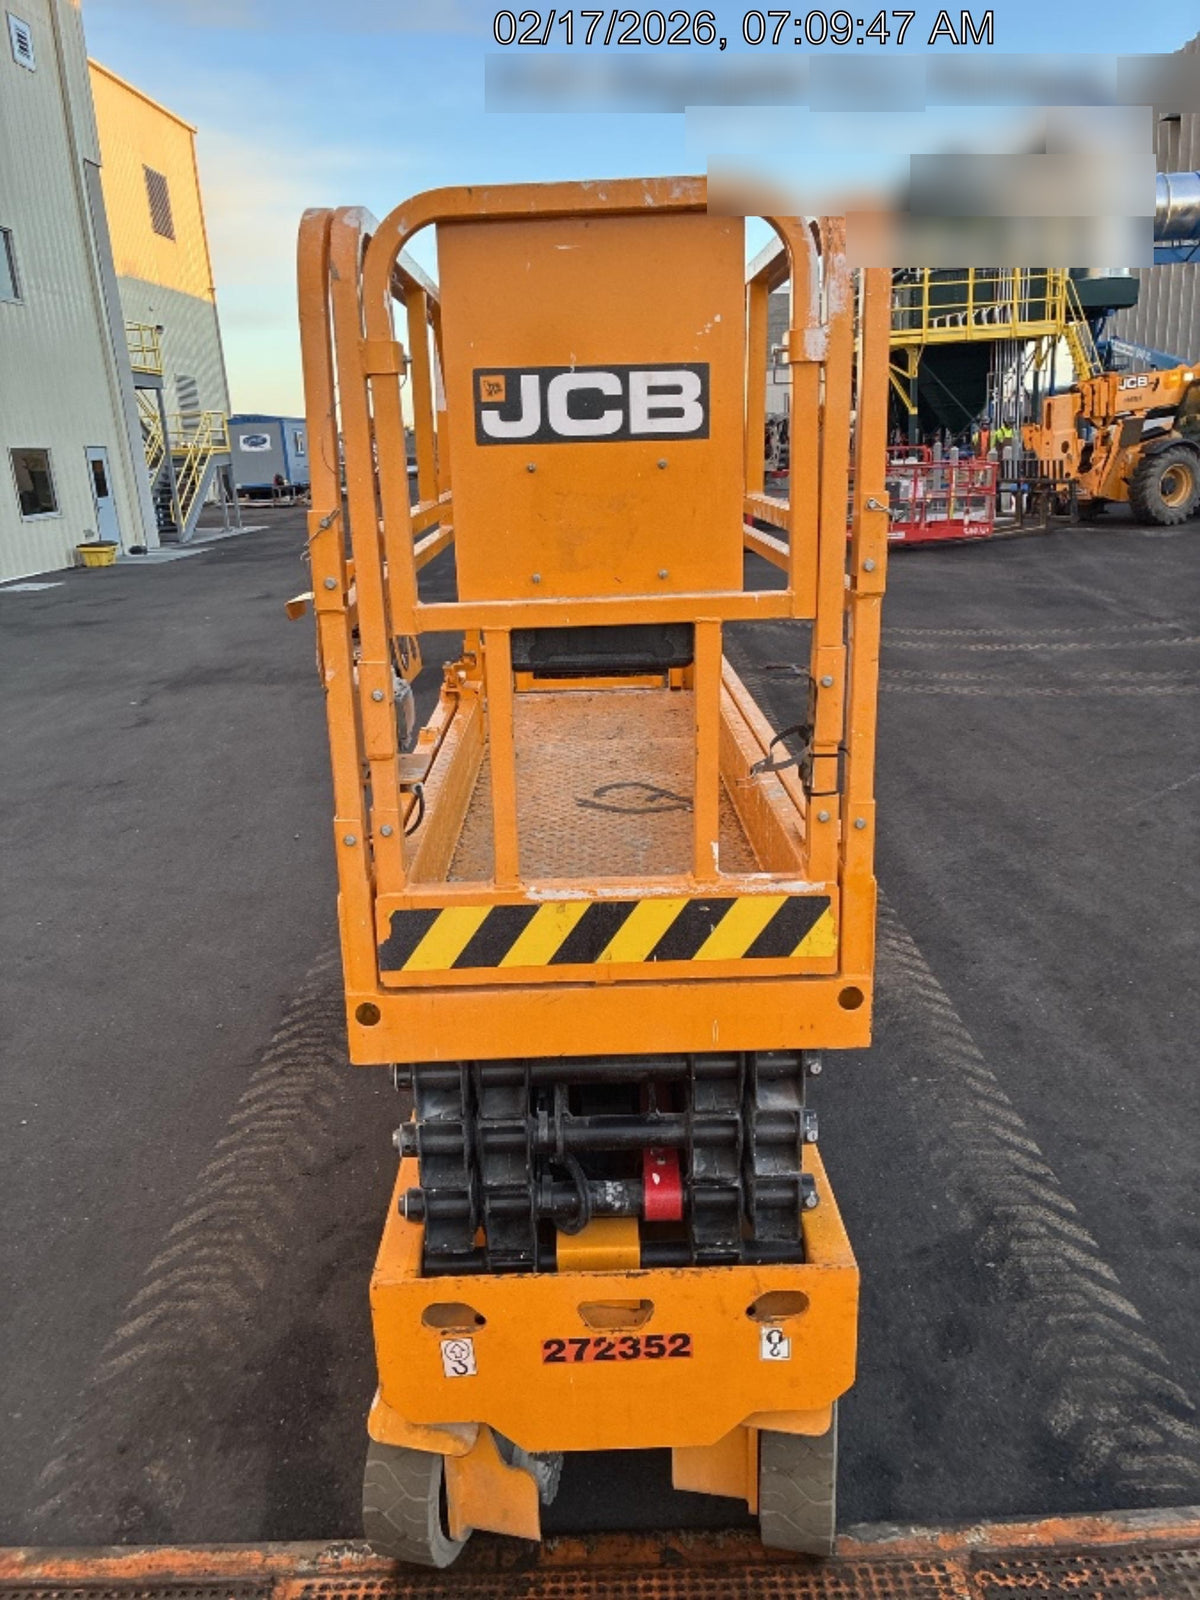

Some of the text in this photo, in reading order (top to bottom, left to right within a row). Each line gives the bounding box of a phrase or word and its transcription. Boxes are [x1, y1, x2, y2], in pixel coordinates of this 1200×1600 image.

[1118, 375, 1149, 391] JCB
[480, 369, 704, 439] JCB
[542, 1333, 692, 1363] 272352
